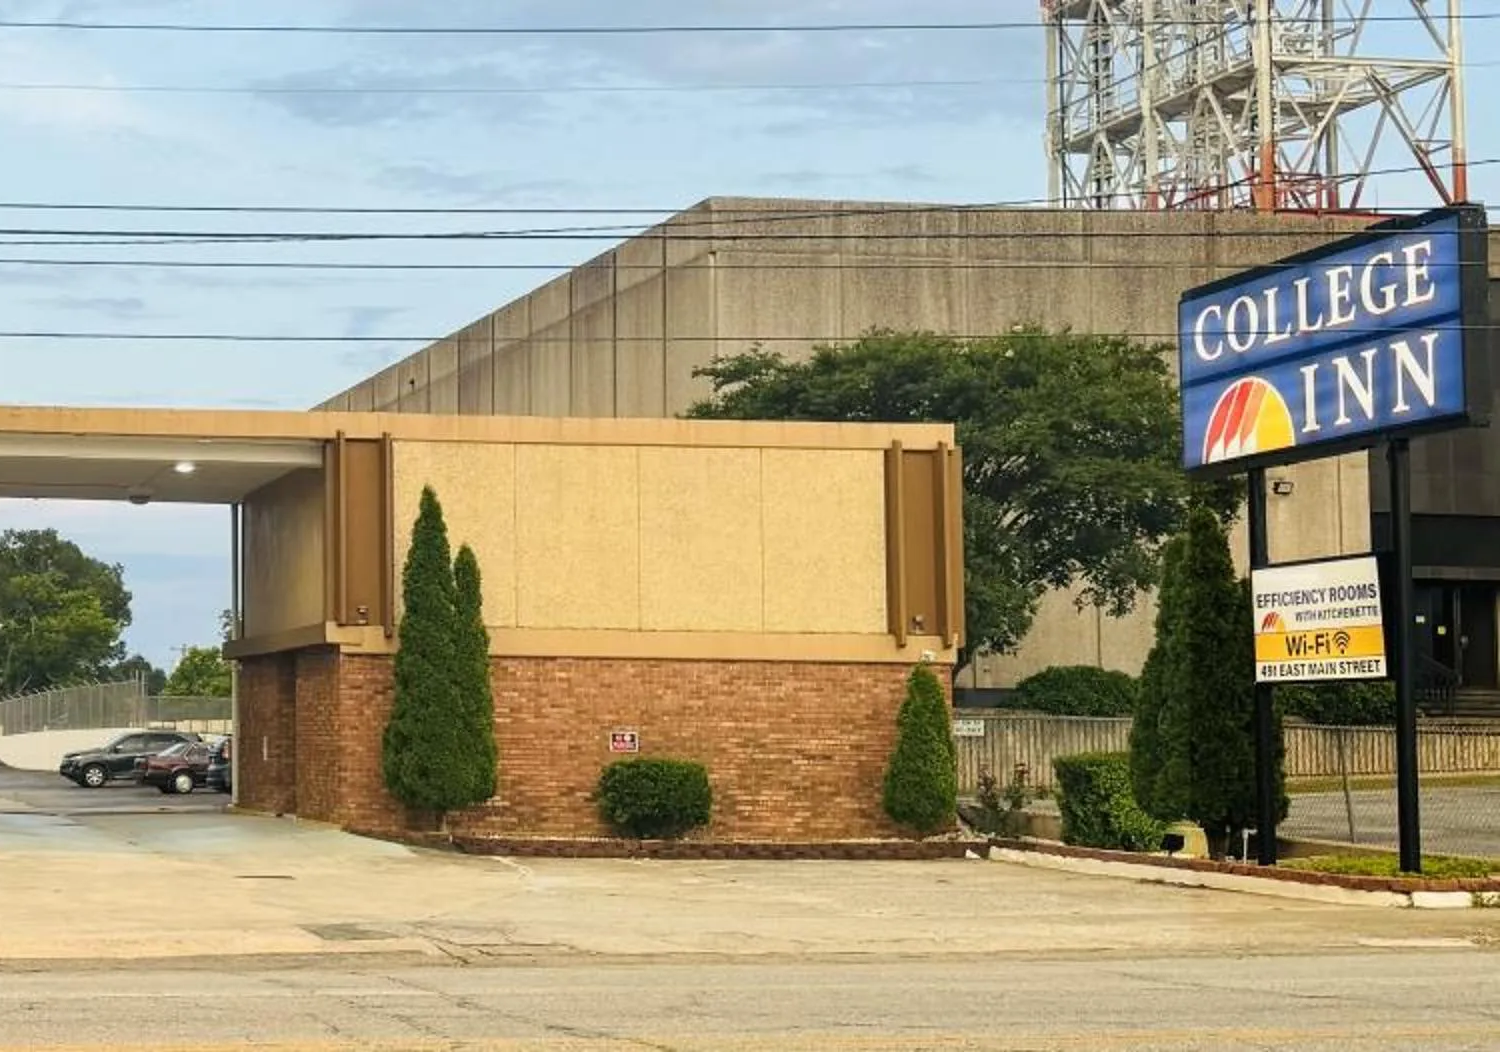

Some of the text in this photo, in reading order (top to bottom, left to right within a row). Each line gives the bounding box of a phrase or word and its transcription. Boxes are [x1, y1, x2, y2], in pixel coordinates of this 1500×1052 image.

[1193, 240, 1436, 361] COLLEGE
[1300, 333, 1439, 433] INN
[1256, 583, 1377, 609] EFFICIENCY ROOMS
[1294, 610, 1317, 622] WITH
[1285, 632, 1331, 657] Wi-Fi
[1279, 663, 1306, 677] EAST
[1308, 661, 1337, 676] MAIN
[1339, 659, 1381, 674] STREET
